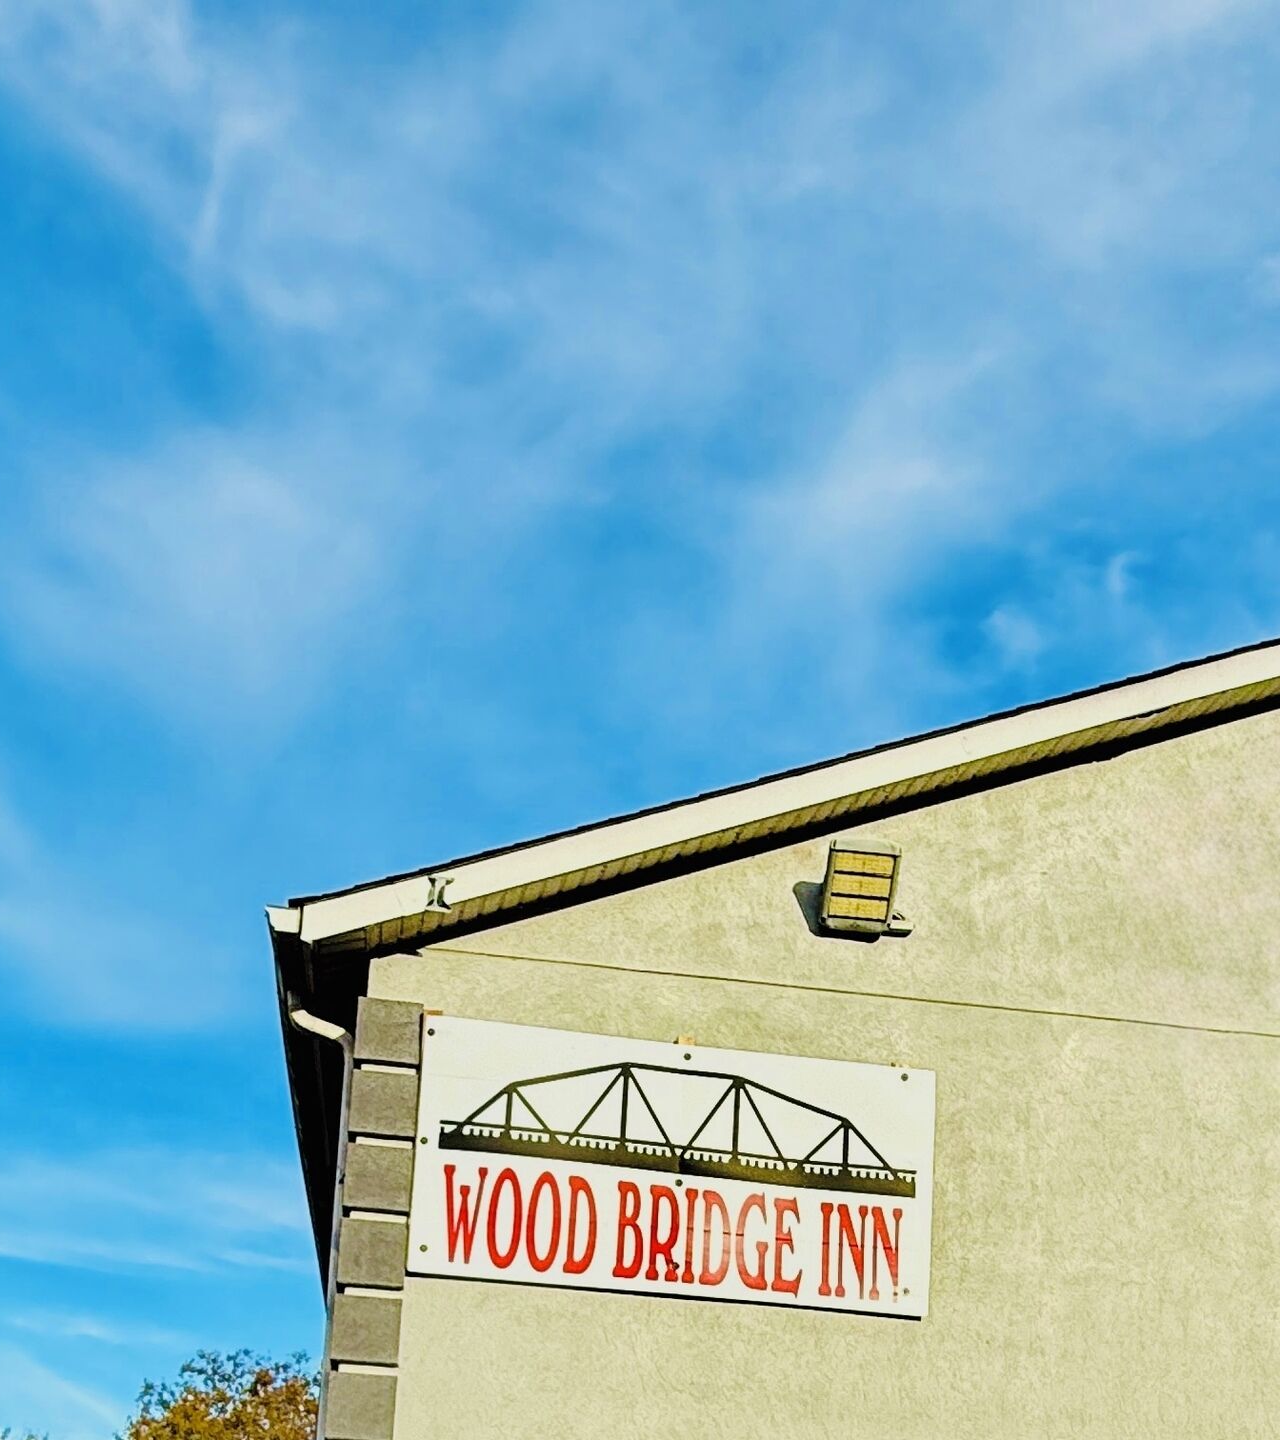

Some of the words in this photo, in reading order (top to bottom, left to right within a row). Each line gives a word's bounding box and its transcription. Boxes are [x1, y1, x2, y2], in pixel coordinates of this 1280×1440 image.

[442, 1163, 598, 1275] WOOD
[611, 1180, 803, 1298] BRIDGE
[817, 1201, 904, 1302] INN
